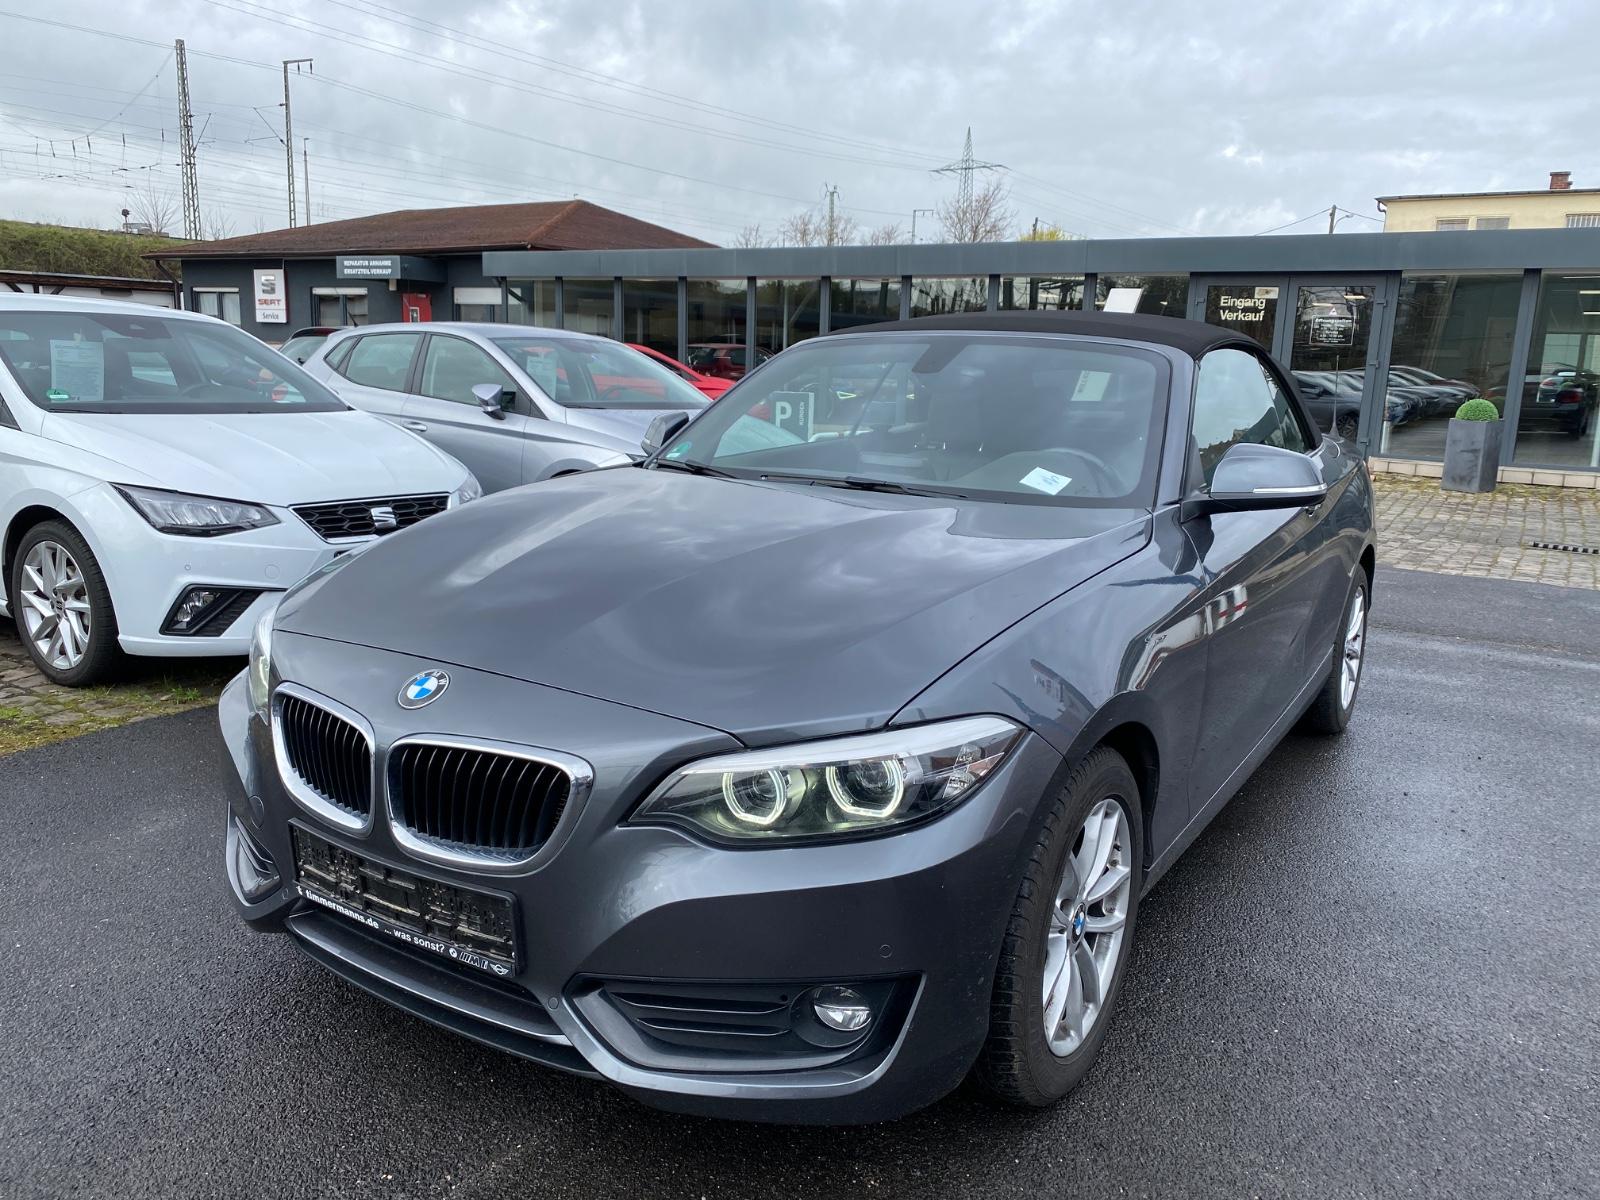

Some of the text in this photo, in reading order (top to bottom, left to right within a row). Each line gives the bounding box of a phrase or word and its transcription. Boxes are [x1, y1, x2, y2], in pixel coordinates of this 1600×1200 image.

[257, 298, 281, 306] SEAT
[1220, 295, 1266, 310] Eingang
[262, 312, 279, 320] Service
[1220, 309, 1265, 321] Verkauf
[775, 401, 792, 428] P
[305, 889, 379, 929] timmermanns.de
[393, 929, 412, 942] was
[413, 936, 445, 953] sonst?
